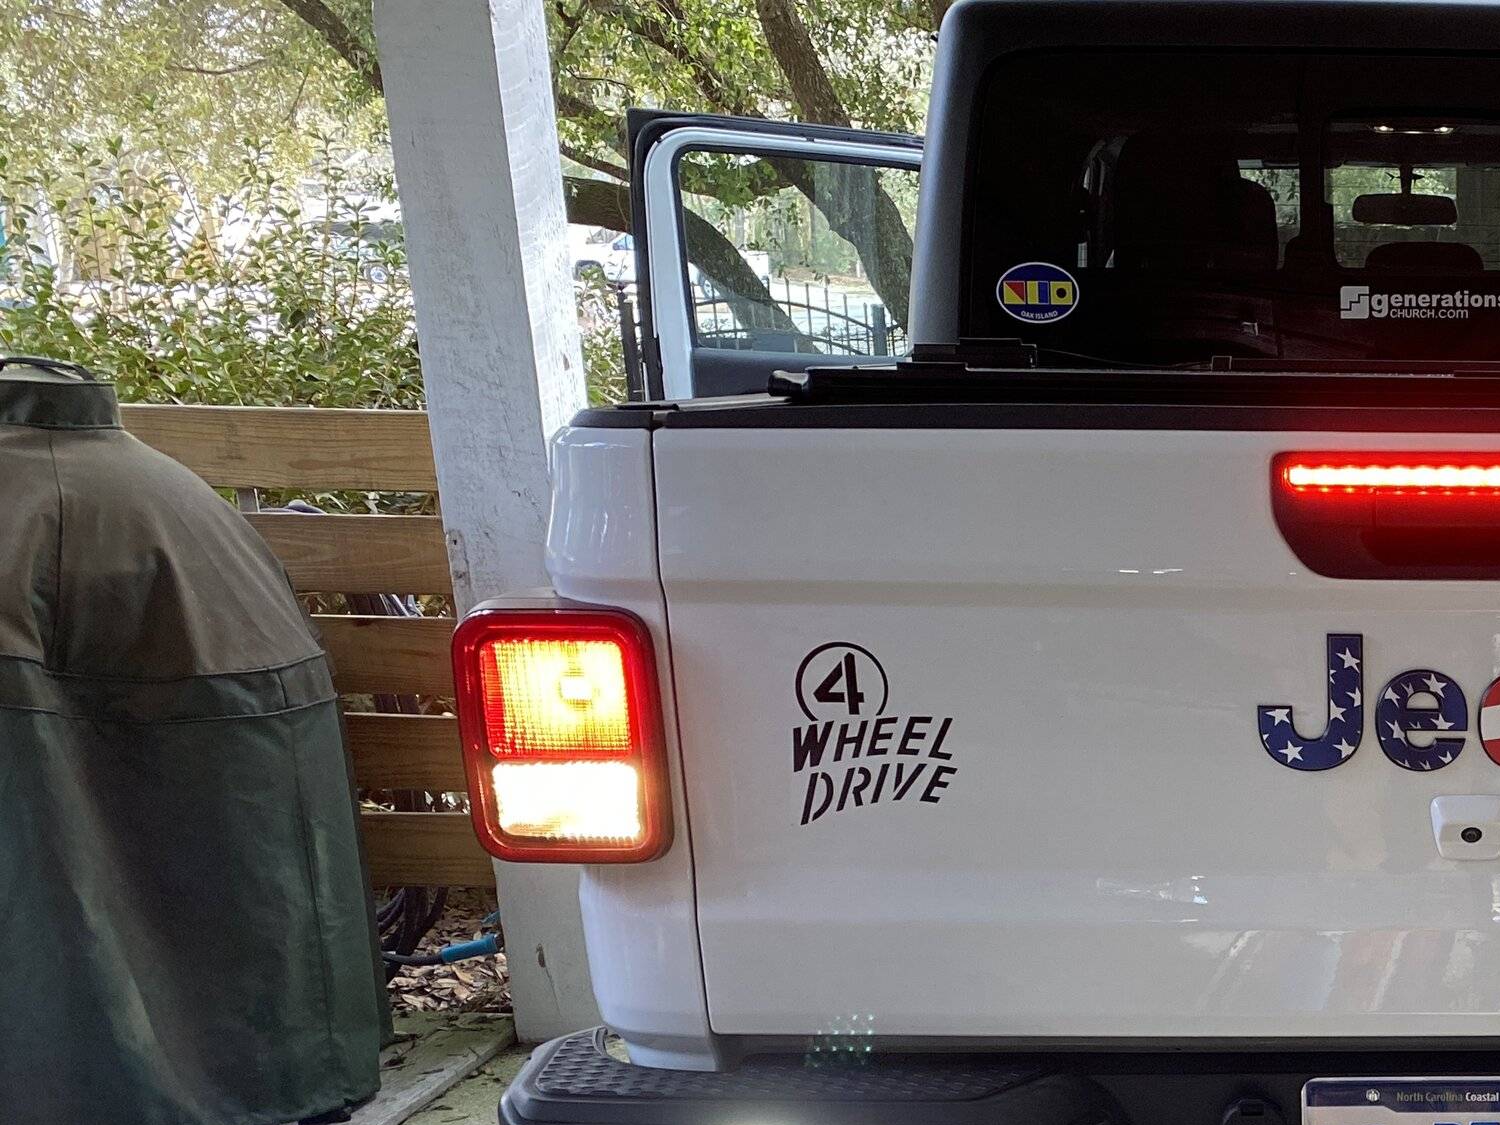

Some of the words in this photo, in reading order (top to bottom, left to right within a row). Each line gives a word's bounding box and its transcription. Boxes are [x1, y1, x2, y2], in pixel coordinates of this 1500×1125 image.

[1020, 310, 1034, 318] OAK
[1035, 310, 1058, 319] ISLAND
[1389, 308, 1469, 319] CHURCH.com
[813, 651, 865, 715] 4
[793, 716, 953, 773] WHEEL
[800, 763, 958, 826] DRIVE
[1396, 1091, 1424, 1102] North
[1425, 1091, 1463, 1102] Carolina
[1465, 1091, 1500, 1102] Coastal
